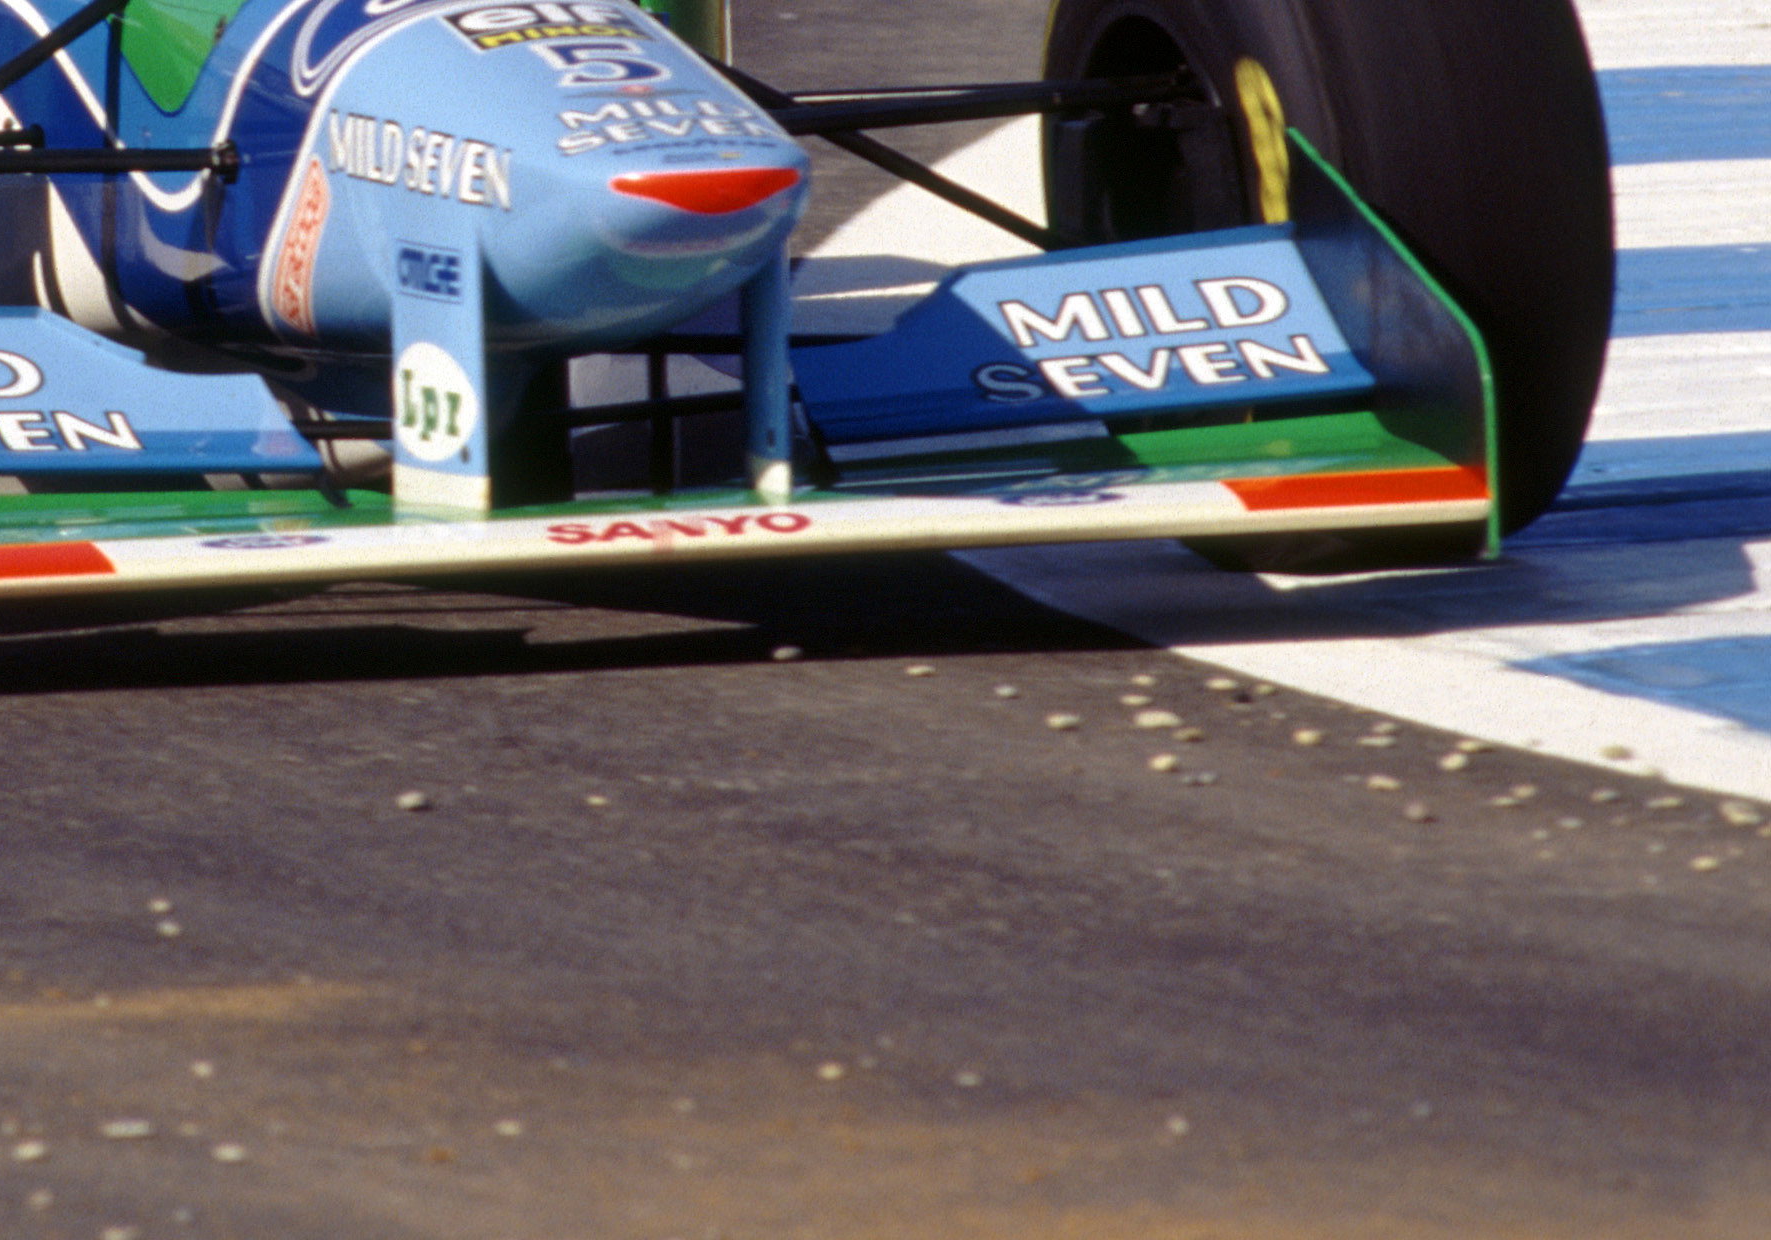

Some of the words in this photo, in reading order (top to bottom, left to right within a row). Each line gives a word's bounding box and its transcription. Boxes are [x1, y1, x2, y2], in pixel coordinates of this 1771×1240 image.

[457, 1, 631, 31] elf
[531, 38, 671, 88] 5
[558, 98, 753, 131] MILD
[329, 108, 405, 186] MILD
[405, 125, 514, 212] SEVEN
[998, 275, 1291, 349] MILD
[973, 334, 1332, 406] SEVEN
[546, 511, 813, 546] SANYO
